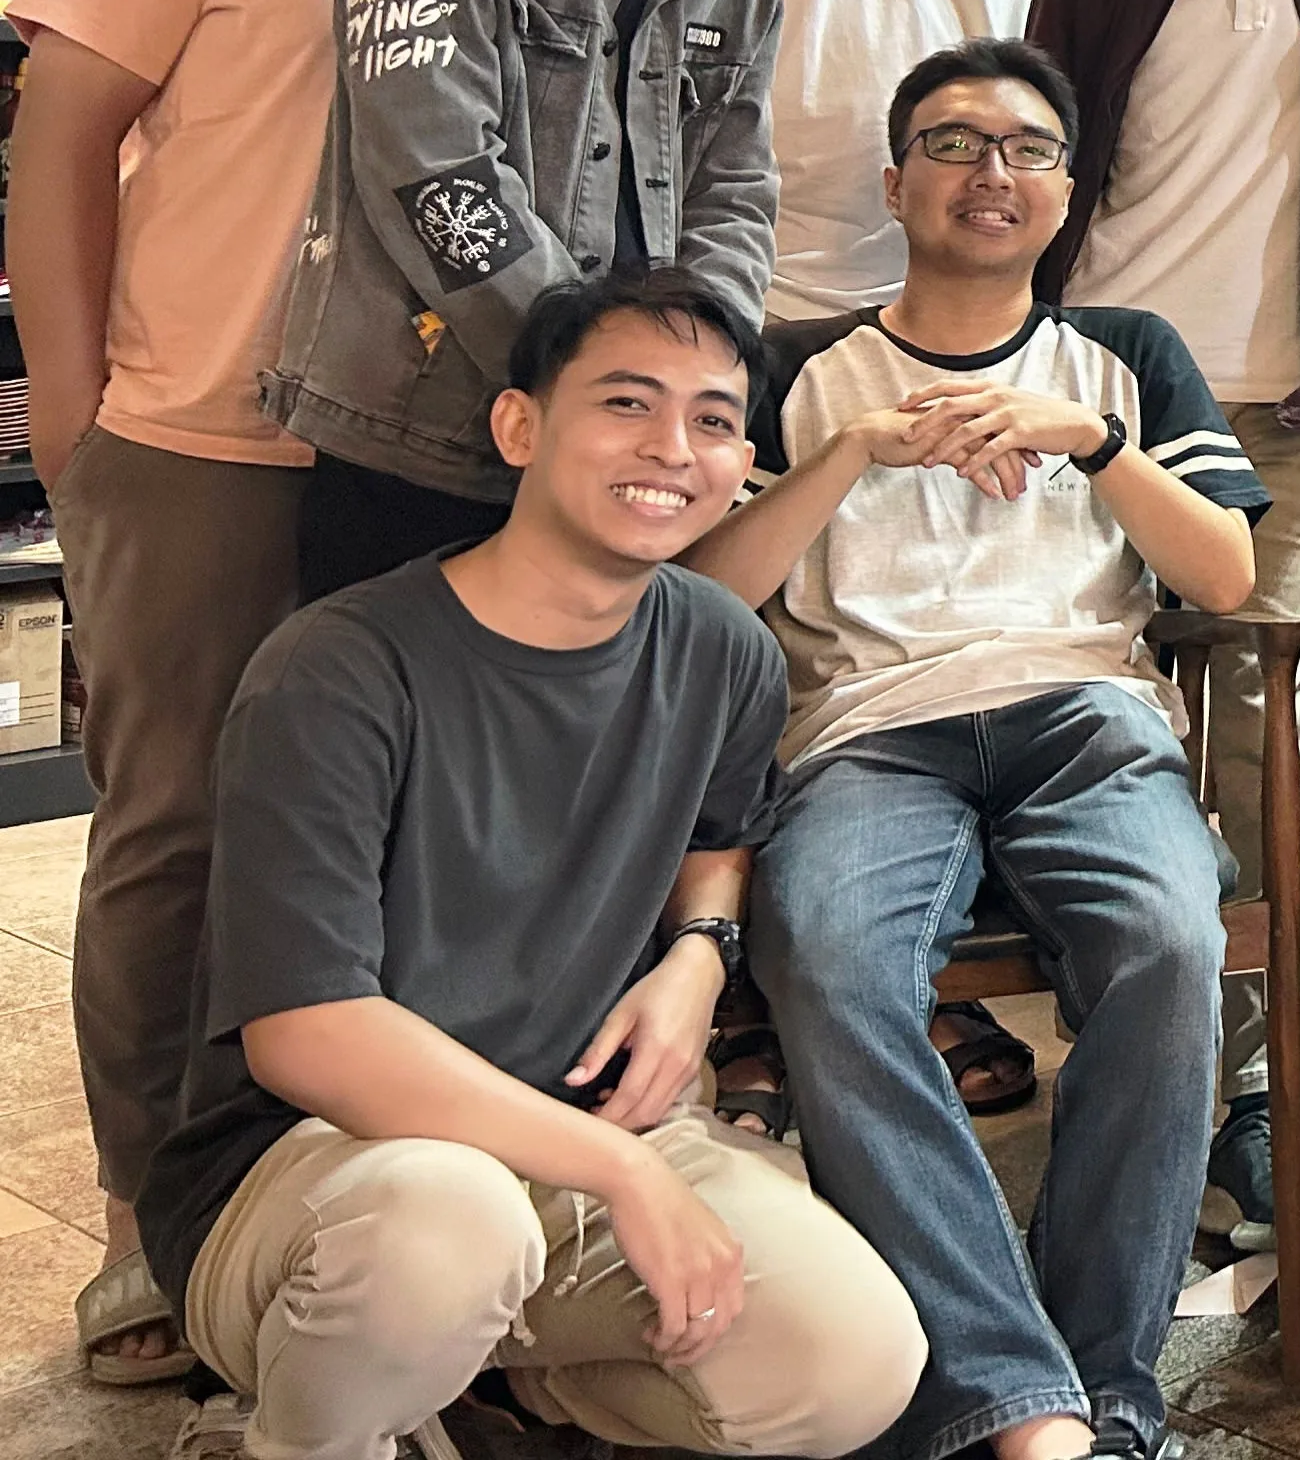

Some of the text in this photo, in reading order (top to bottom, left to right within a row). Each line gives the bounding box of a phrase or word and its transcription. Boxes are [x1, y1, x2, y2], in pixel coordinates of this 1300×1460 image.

[439, 2, 458, 17] OF
[1047, 482, 1075, 492] NEW
[18, 615, 56, 628] EPSON
